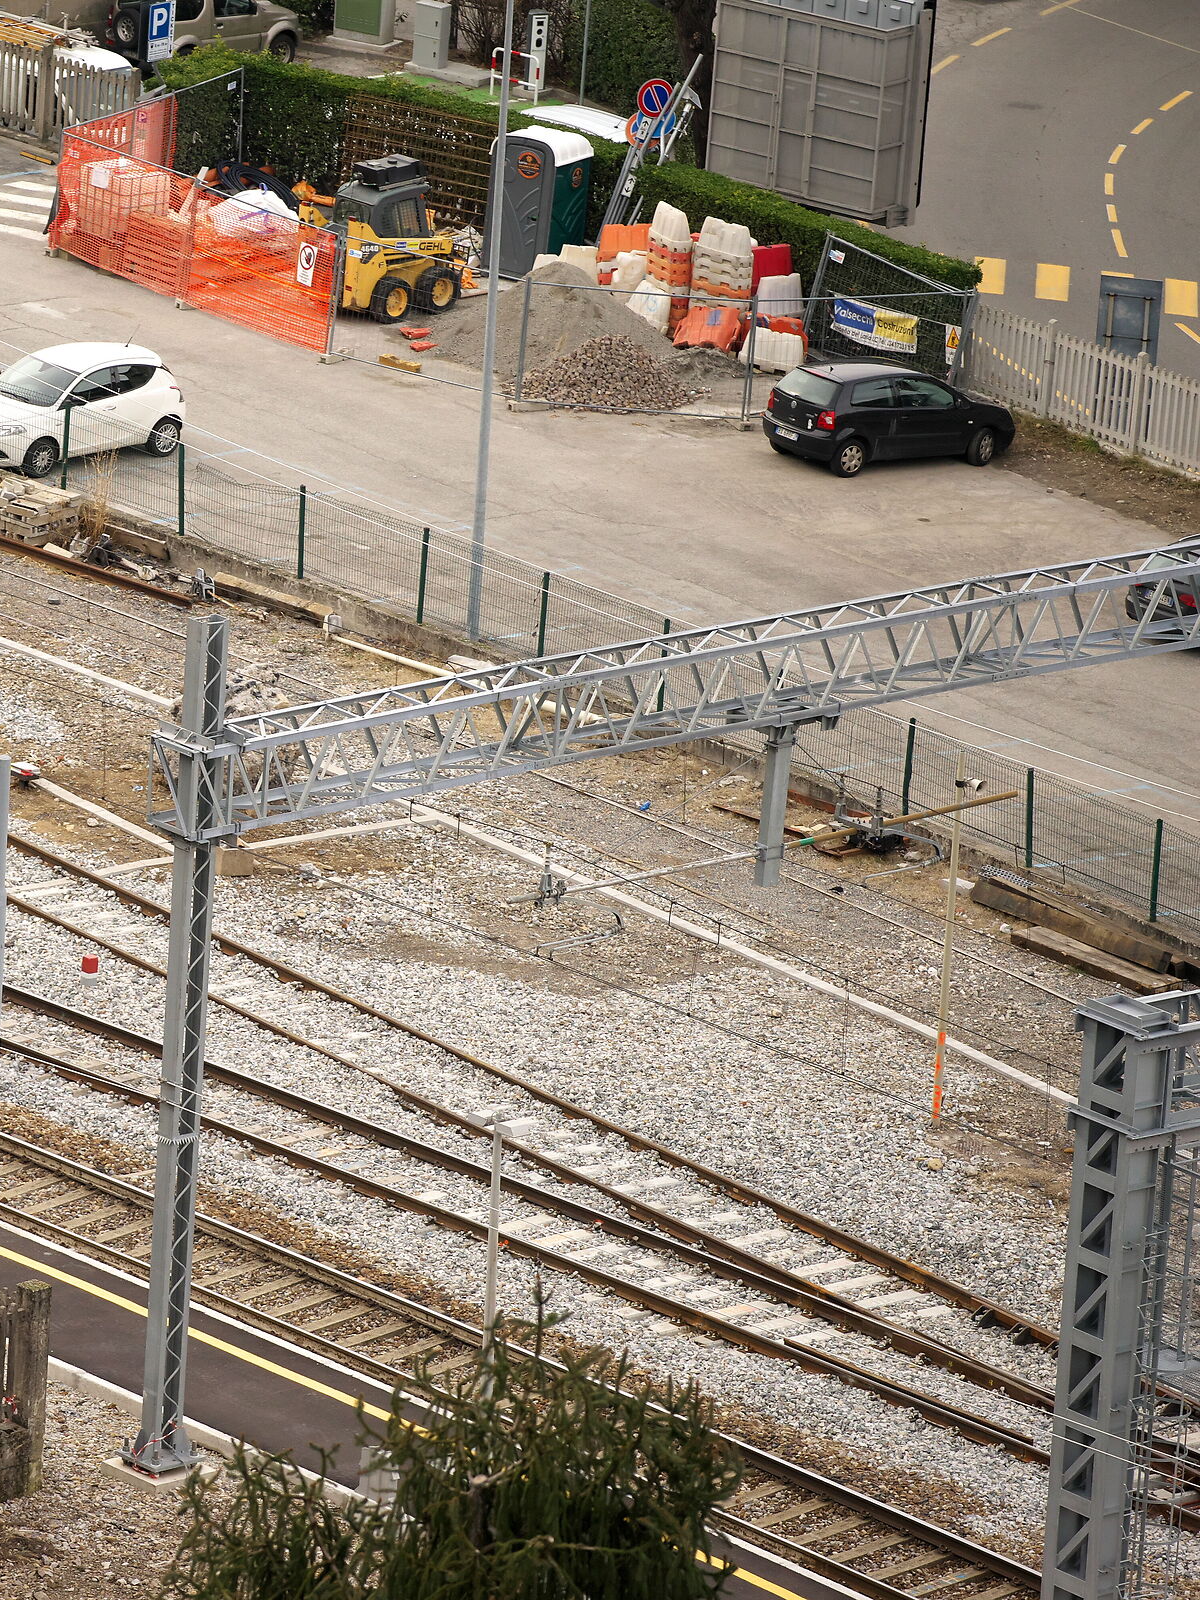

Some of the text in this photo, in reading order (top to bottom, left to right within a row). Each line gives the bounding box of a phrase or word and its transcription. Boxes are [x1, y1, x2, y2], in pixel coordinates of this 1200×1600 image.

[152, 7, 168, 36] P
[418, 242, 446, 251] GEHL
[834, 305, 914, 336] Valsecchi Costruzioni
